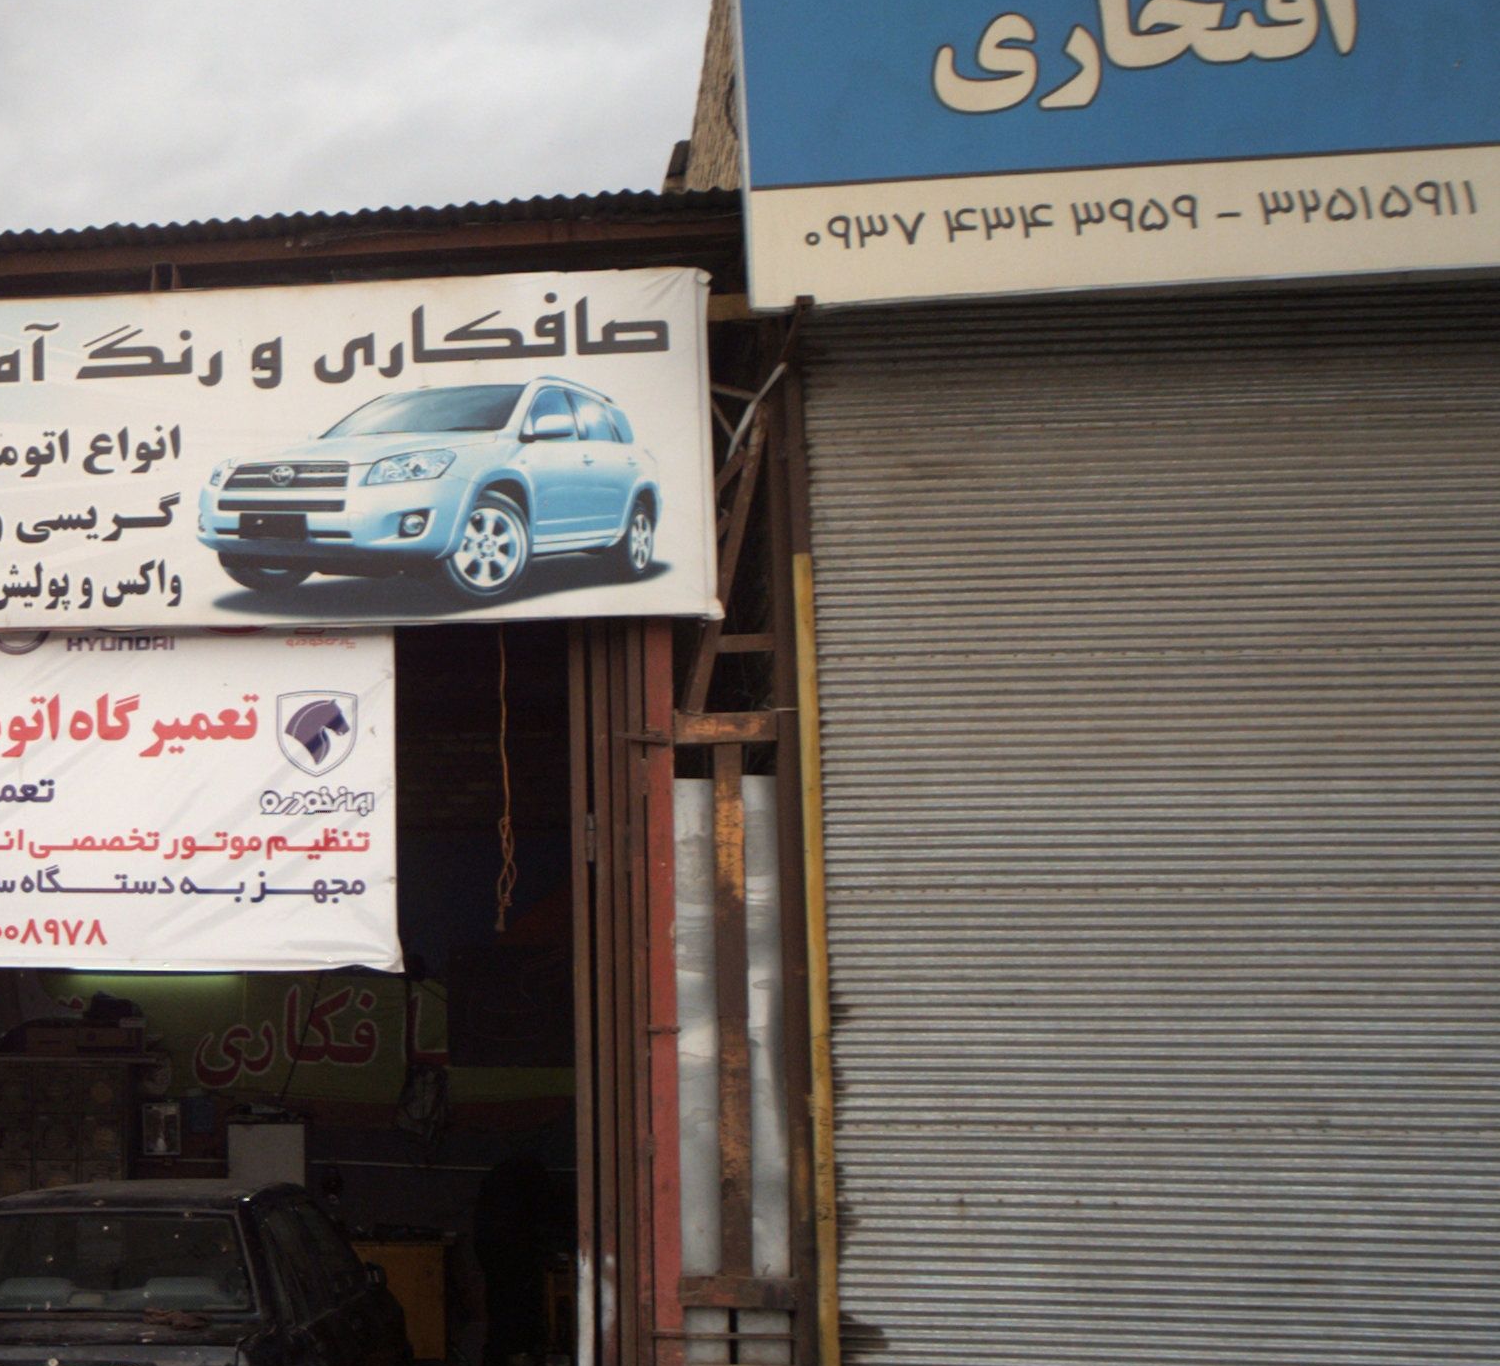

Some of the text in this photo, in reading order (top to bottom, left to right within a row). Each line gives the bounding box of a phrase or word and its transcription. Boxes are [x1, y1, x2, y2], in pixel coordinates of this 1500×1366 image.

[805, 181, 1476, 249] ۰۹۳۷ ۴۳۴ ۳۹۵۹ ۳۲۵۱۵۹۱۱
[314, 293, 670, 383] صافکاری
[76, 325, 222, 386] رنگ
[252, 337, 282, 389] و
[83, 425, 180, 475] انواع
[16, 493, 180, 543] گریسی
[78, 578, 92, 609] و
[102, 560, 181, 607] واکس
[66, 635, 176, 652] HYUNDAI
[28, 827, 161, 860] تخصصی
[163, 830, 275, 861] موتور
[266, 827, 372, 861] تنظیم
[20, 863, 176, 897] دستگاه
[179, 876, 245, 904] به
[249, 871, 367, 905] مجهز
